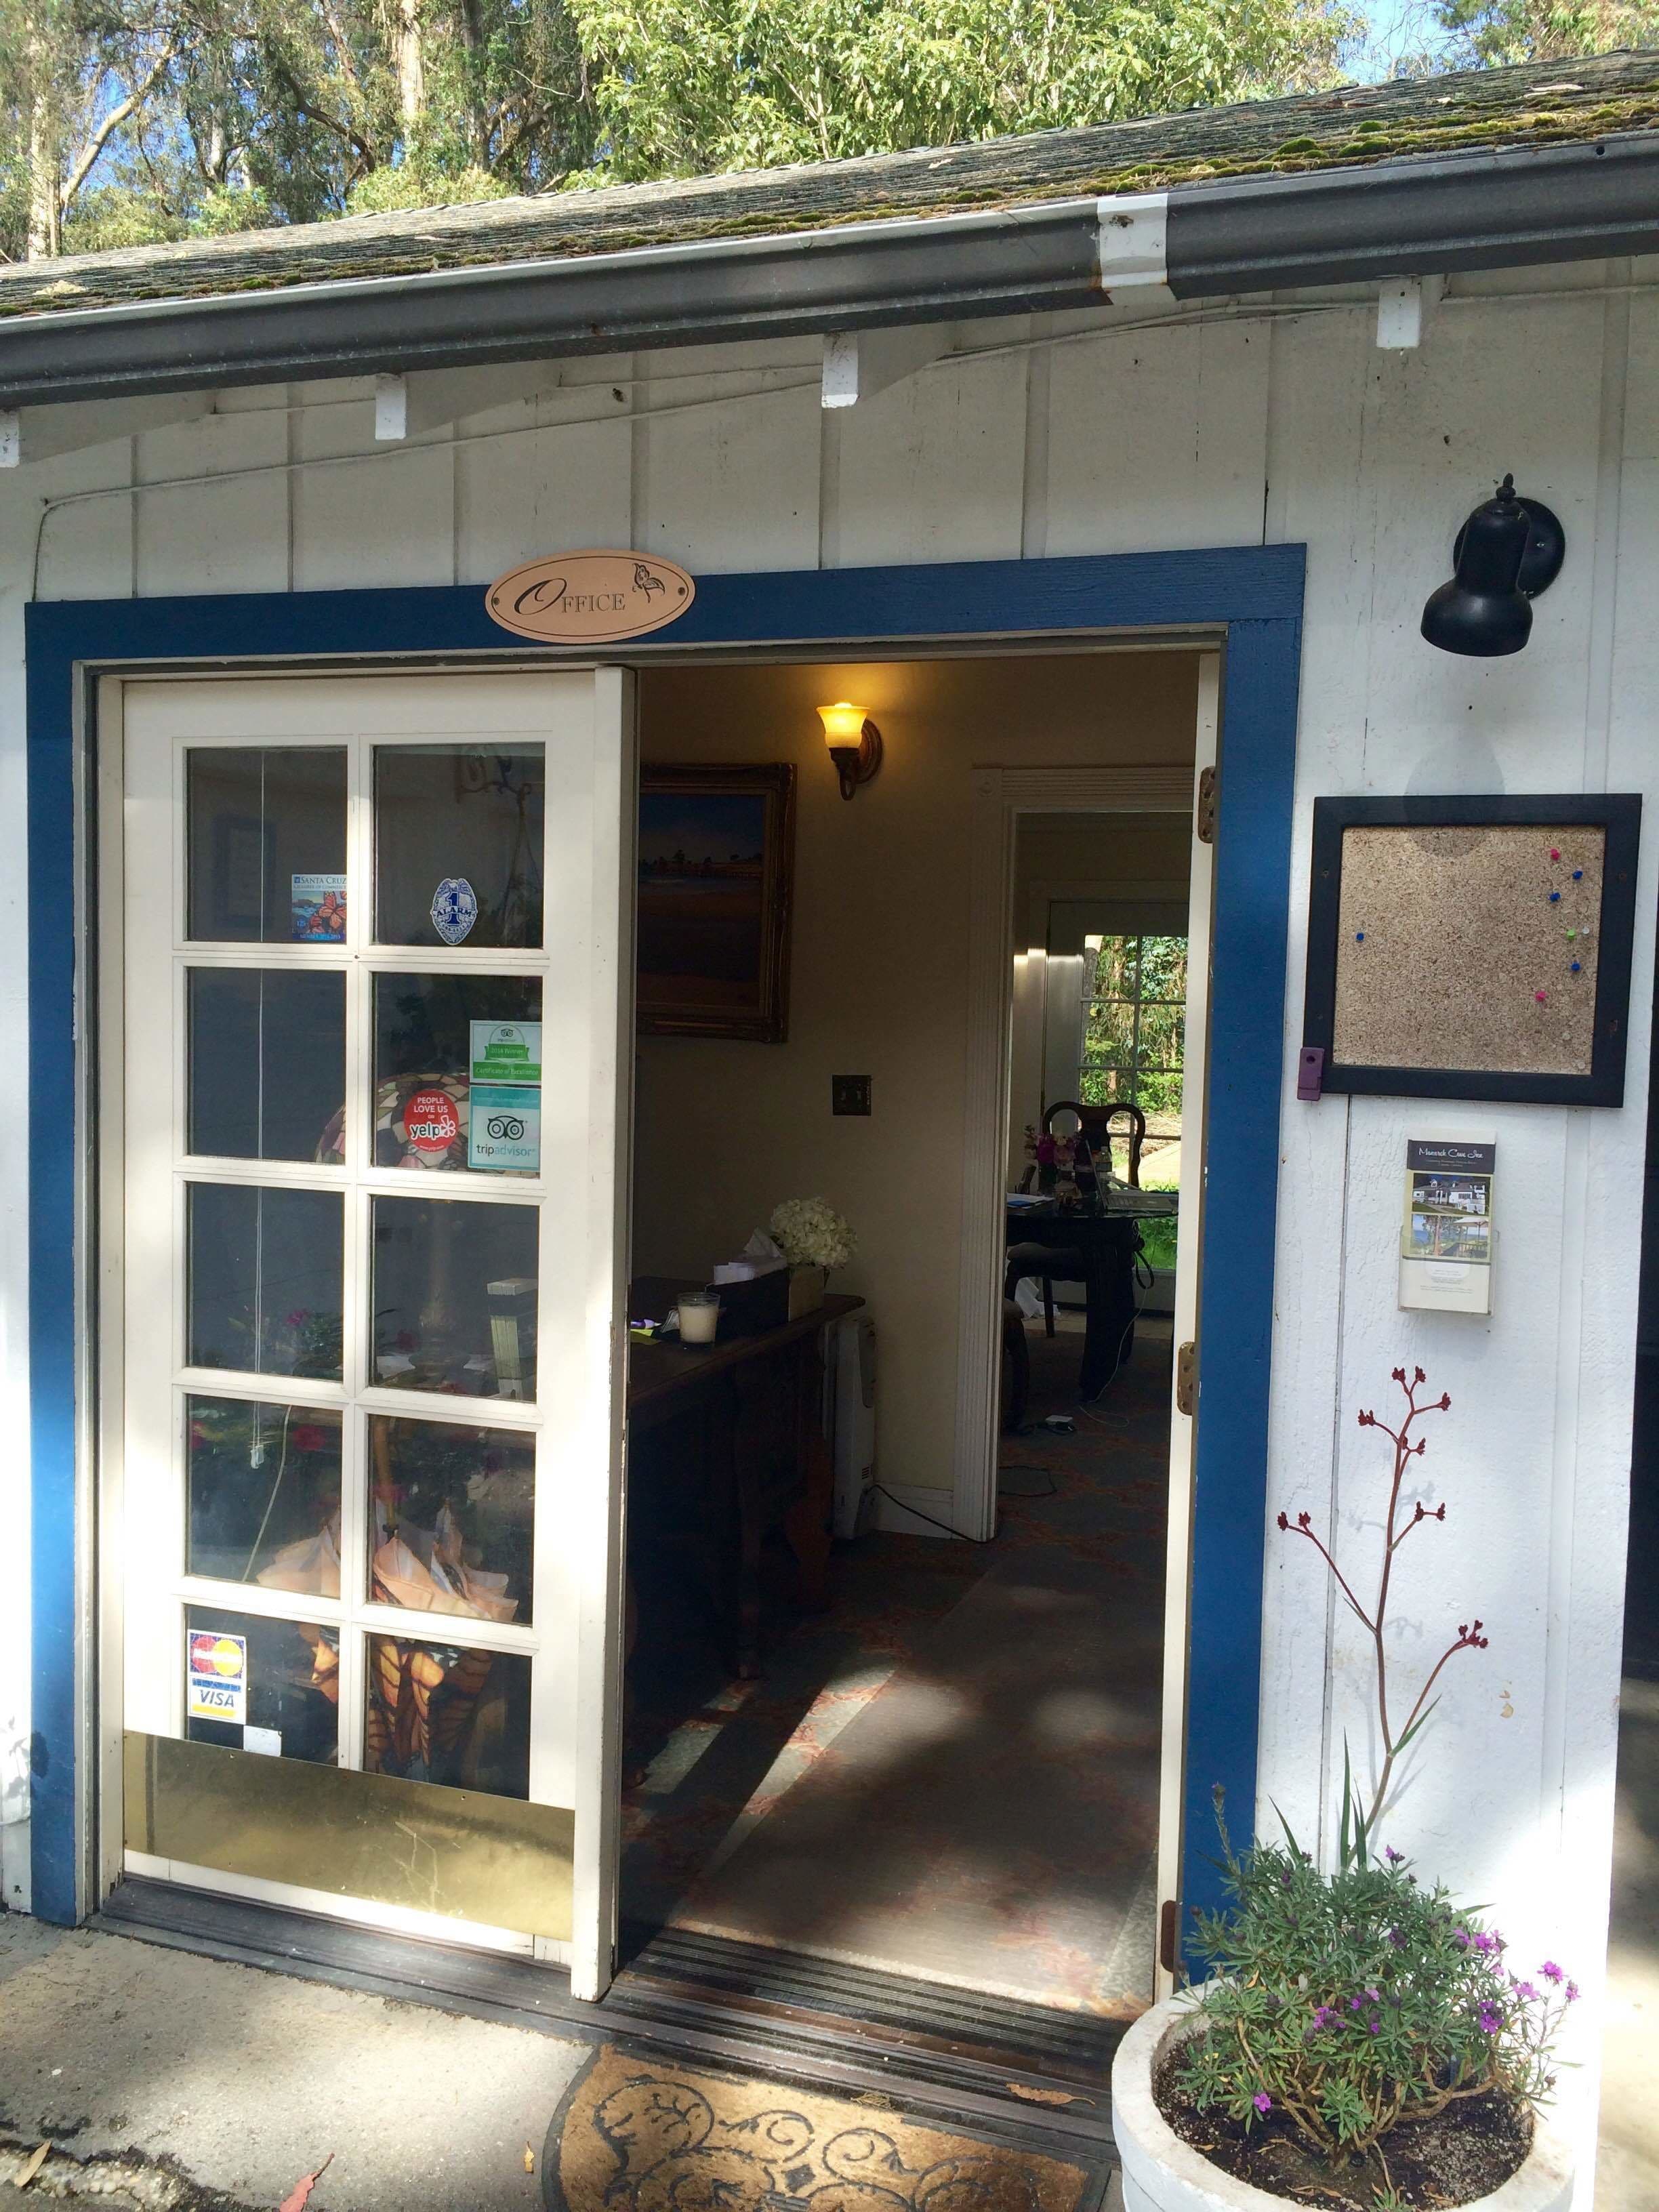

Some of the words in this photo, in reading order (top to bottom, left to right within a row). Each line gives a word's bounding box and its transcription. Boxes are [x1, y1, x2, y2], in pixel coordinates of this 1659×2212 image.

[514, 577, 626, 615] OFFICE
[326, 876, 347, 884] CRUZ
[436, 907, 472, 918] ALARM
[410, 1122, 440, 1139] yelp
[476, 1144, 533, 1157] tripadvisor
[199, 1689, 234, 1708] VISA
